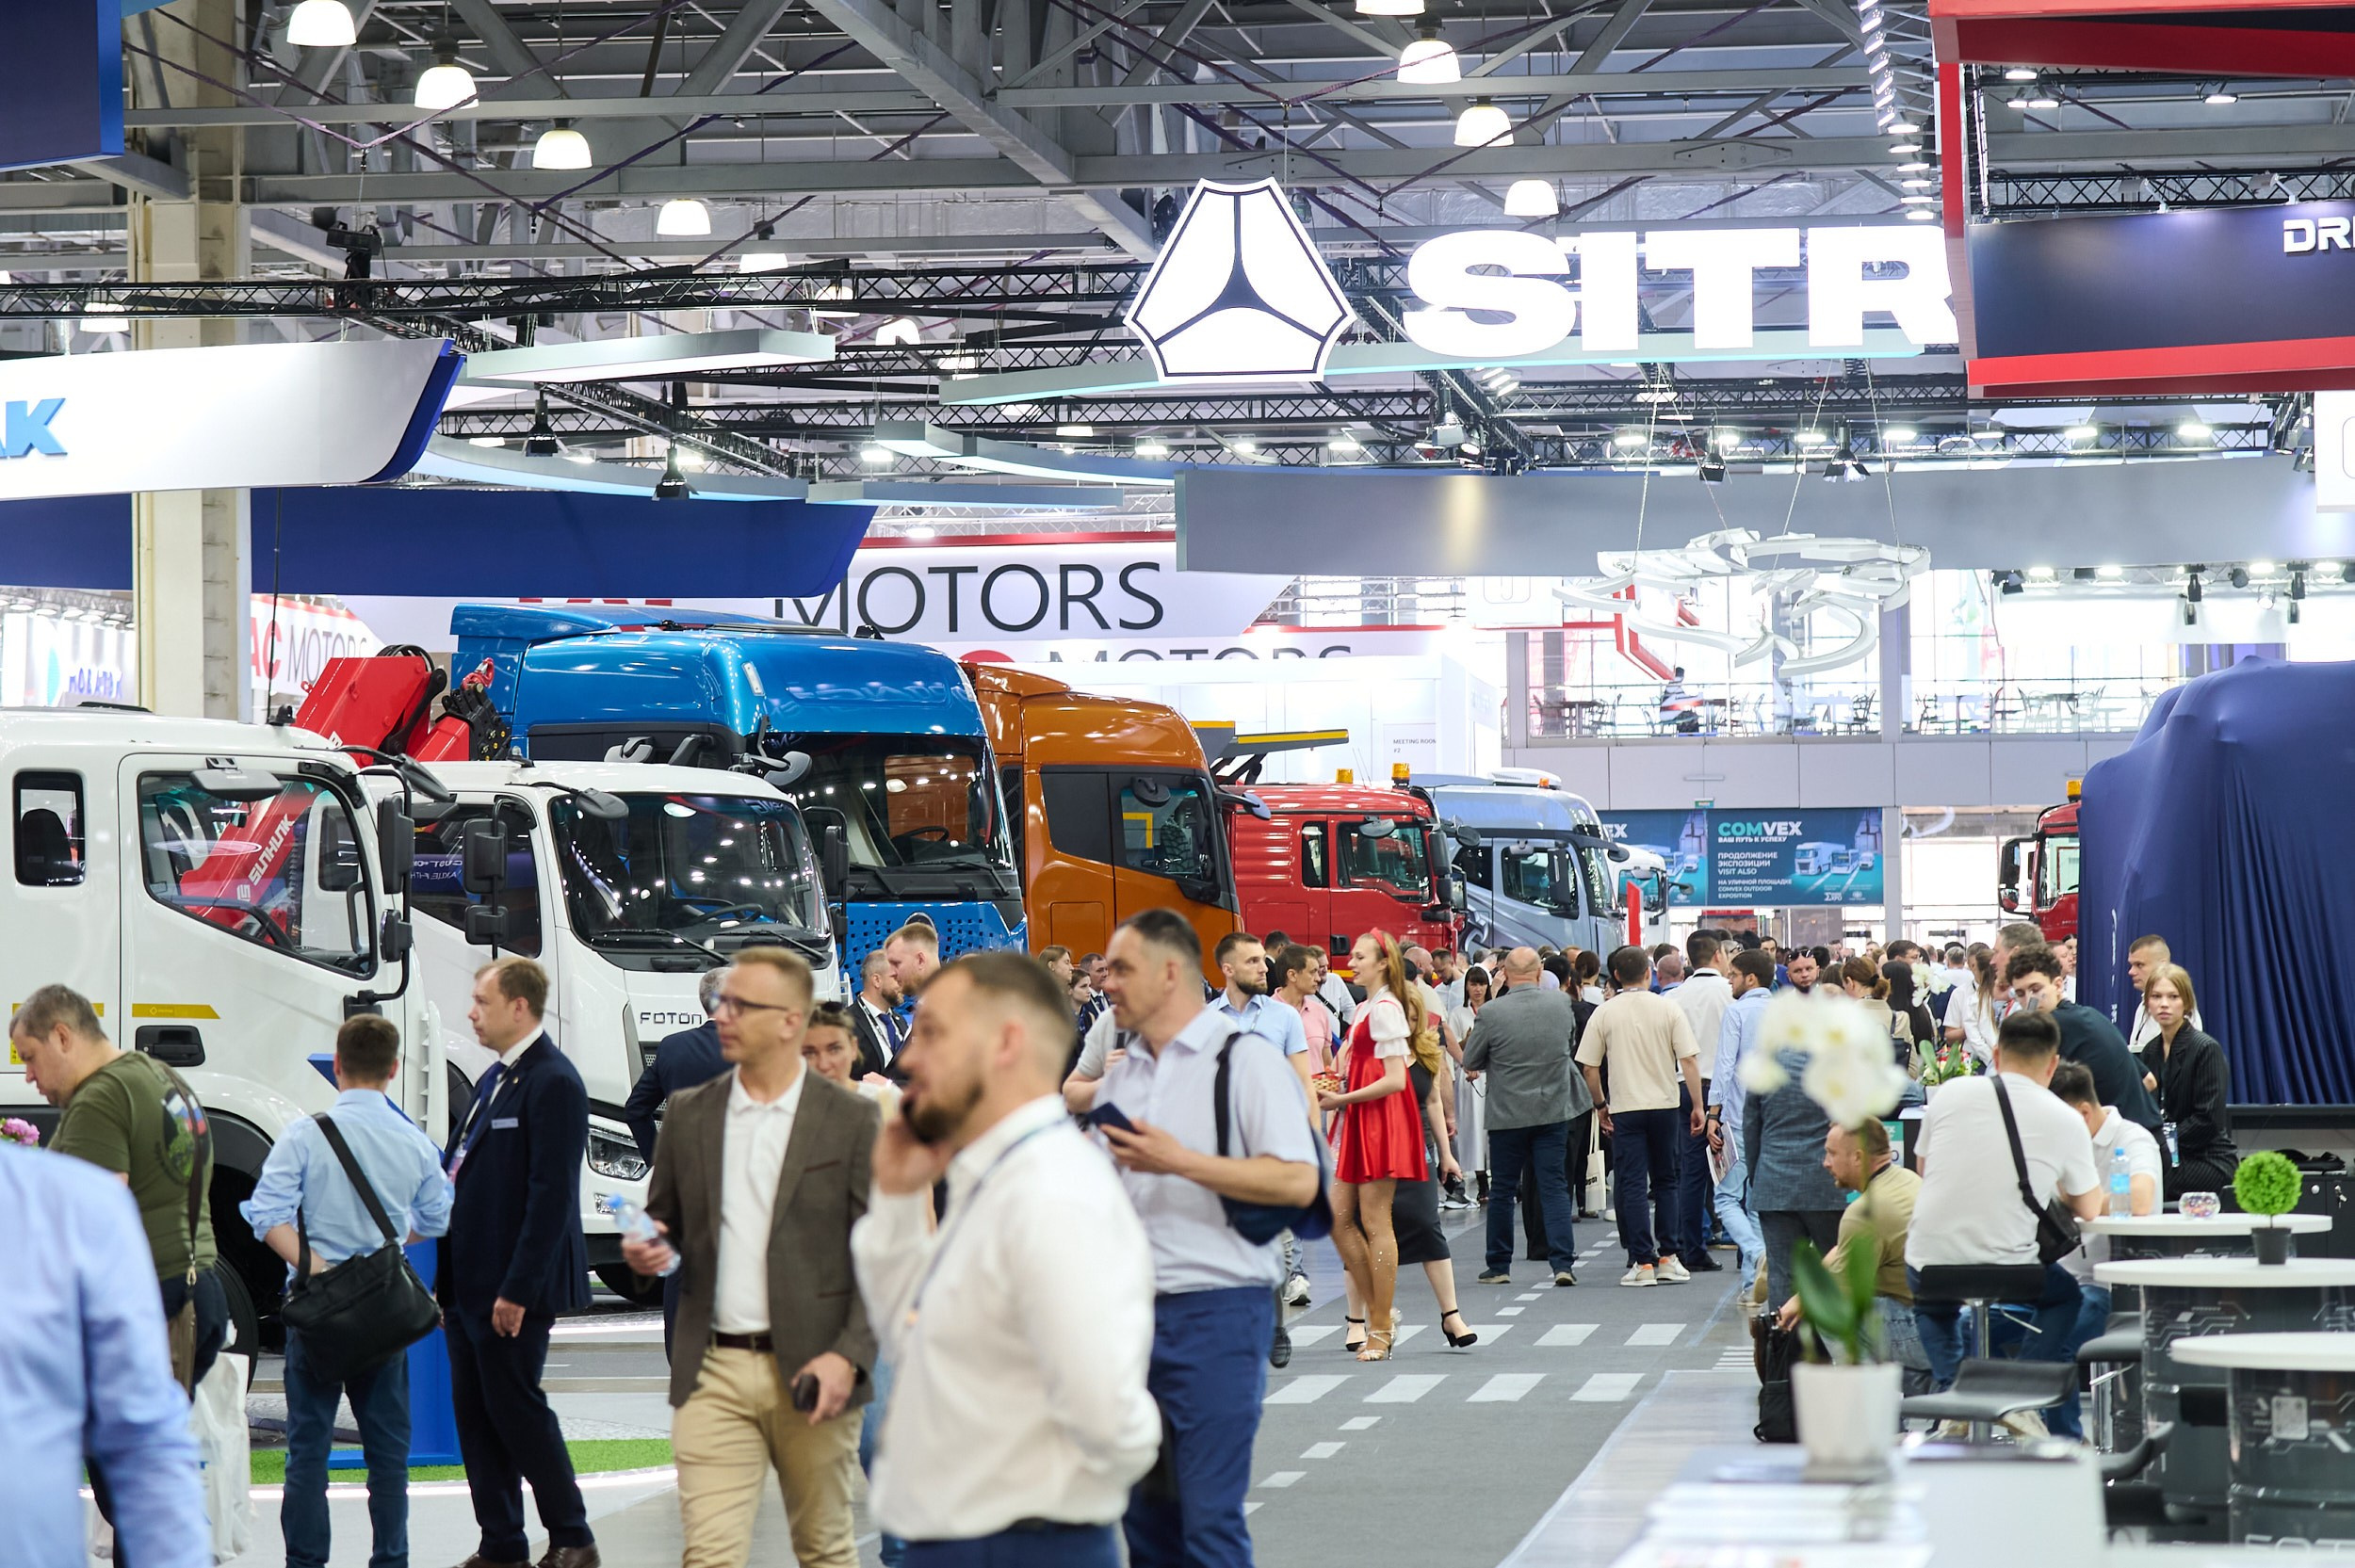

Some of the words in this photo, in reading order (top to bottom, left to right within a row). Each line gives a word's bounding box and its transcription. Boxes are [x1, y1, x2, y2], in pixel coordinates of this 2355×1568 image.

[2283, 216, 2355, 252] DR
[0, 397, 68, 459] K
[1717, 821, 1803, 837] COMVEX
[248, 813, 296, 886] SUNHUNK
[1717, 851, 1778, 860] ПРОДОЛЖЕНИЕ
[1717, 860, 1771, 868] ЭКСПОЗИЦИИ
[1737, 867, 1758, 876] ALSO
[1728, 878, 1757, 886] УЛИЧНОЙ
